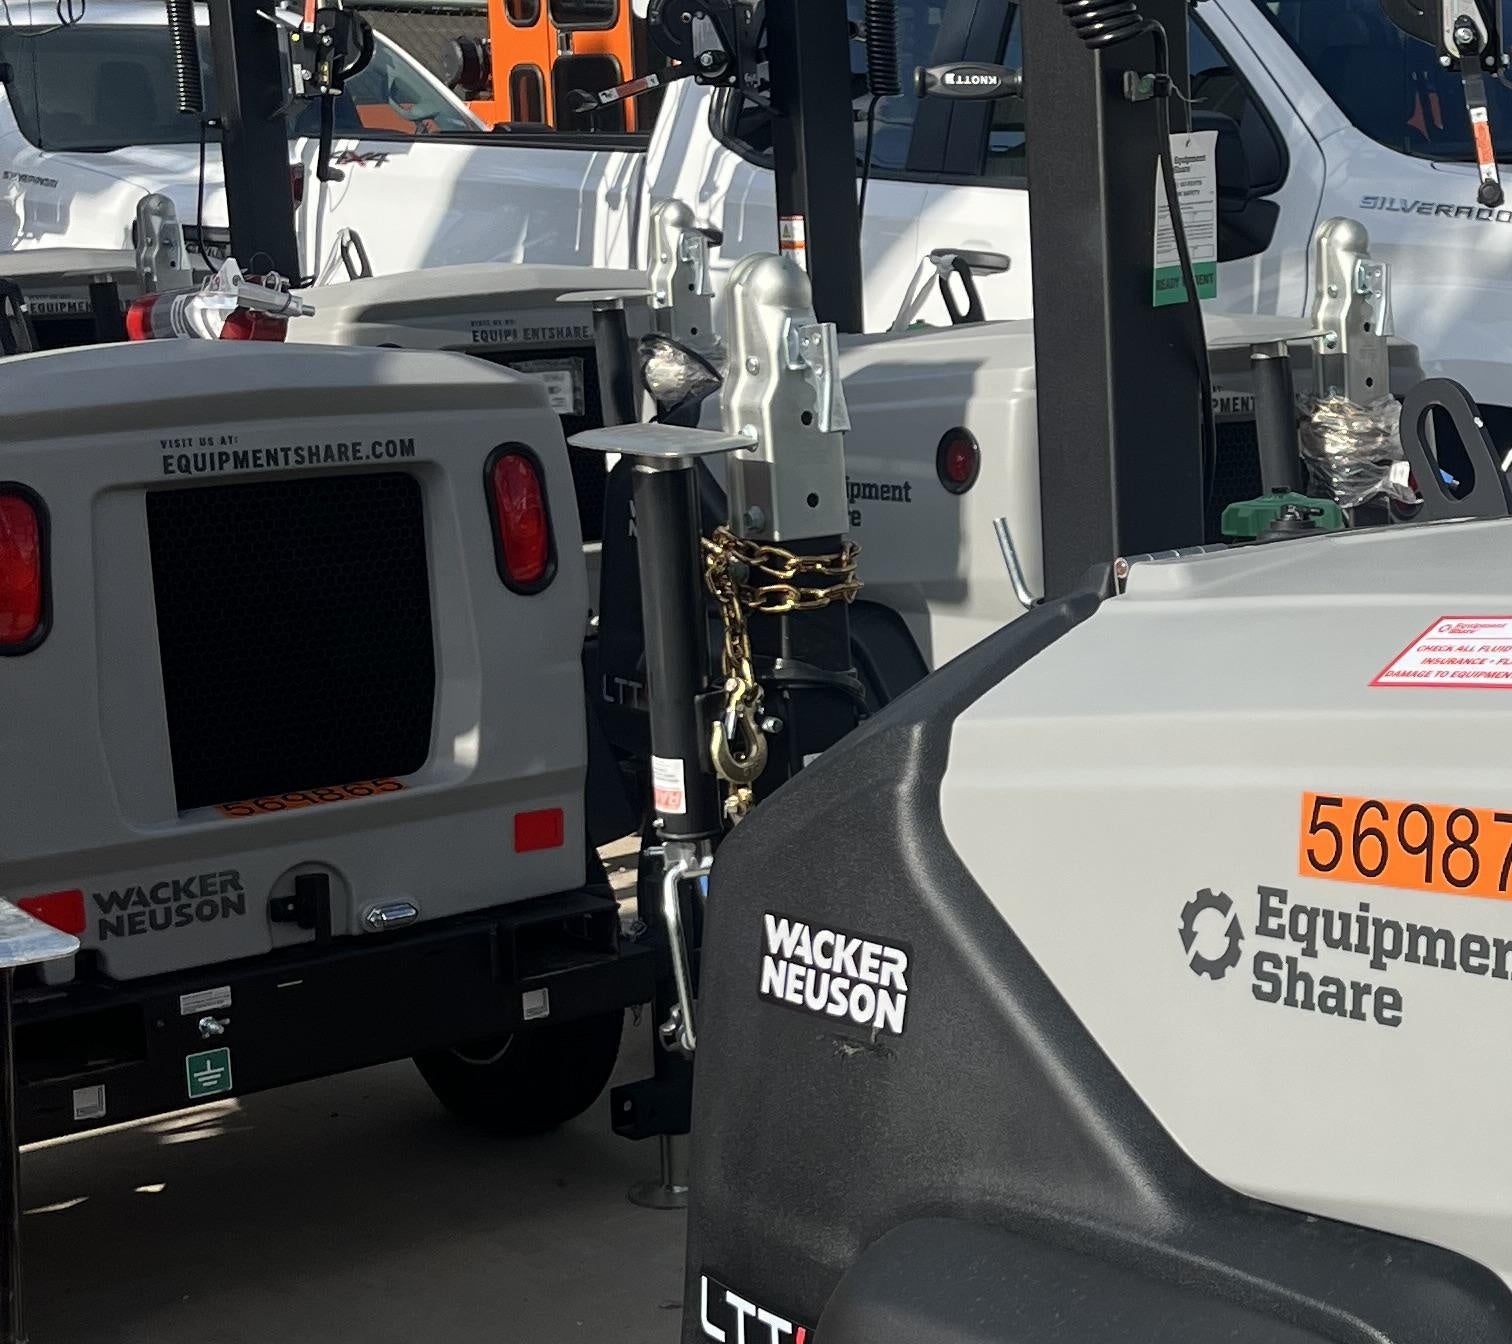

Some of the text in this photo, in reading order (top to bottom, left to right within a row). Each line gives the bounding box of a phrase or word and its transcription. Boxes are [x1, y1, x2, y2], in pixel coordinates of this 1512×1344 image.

[954, 74, 999, 86] KNOTT
[160, 437, 194, 450] VISIT
[199, 436, 215, 447] US
[163, 438, 416, 476] EQUIPMENTSHARE.COM
[1416, 645, 1453, 653] CHECK
[1455, 645, 1475, 653] ALL
[1478, 645, 1512, 653] FLUID
[1420, 657, 1486, 666] INSURANCE
[1384, 670, 1432, 678] DAMAGE
[1434, 670, 1449, 678] TO
[224, 778, 404, 818] 569865
[92, 869, 245, 915] WACKER
[98, 892, 247, 941] NEUSON
[763, 912, 909, 992] WACKER
[760, 955, 908, 1034] NEUSON
[1251, 950, 1404, 1028] Share
